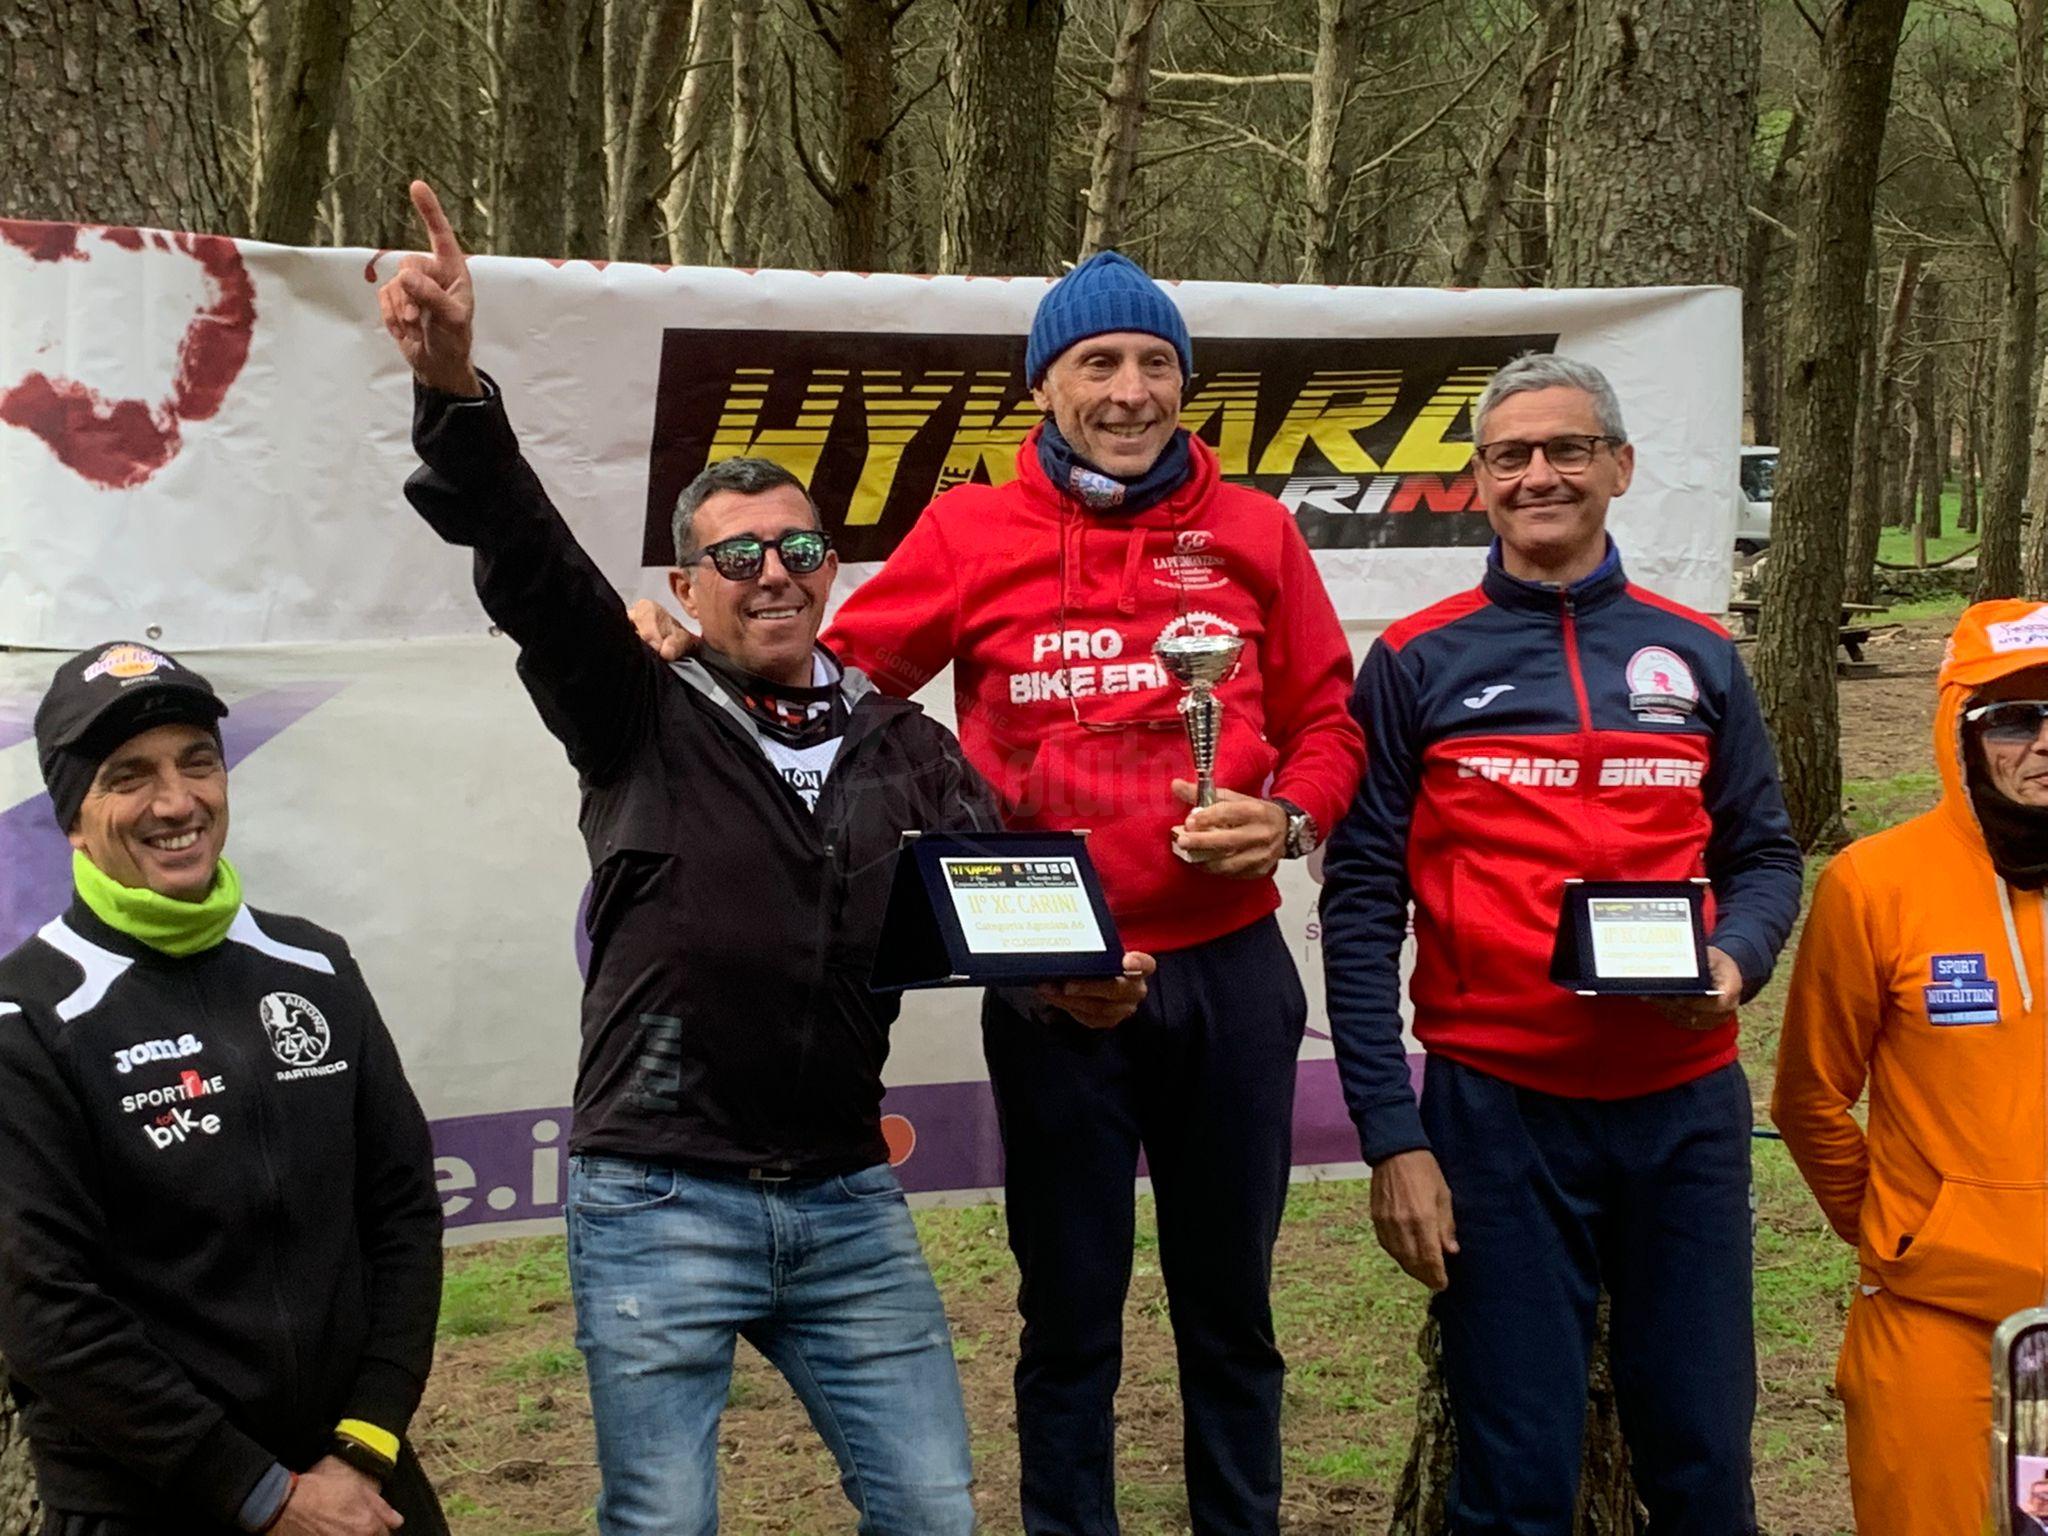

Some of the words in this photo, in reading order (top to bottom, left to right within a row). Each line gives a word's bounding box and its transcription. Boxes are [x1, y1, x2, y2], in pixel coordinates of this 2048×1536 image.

[1033, 628, 1123, 663] PRO
[1009, 666, 1096, 704] BIKE
[1598, 758, 1706, 788] BIKERS
[1016, 894, 1080, 914] CARINI
[1938, 959, 1978, 975] SPORT
[1926, 988, 1994, 1004] NUTRITION
[285, 996, 326, 1034] AIRONE
[276, 1060, 349, 1081] PARTINICO
[144, 1107, 221, 1149] bike
